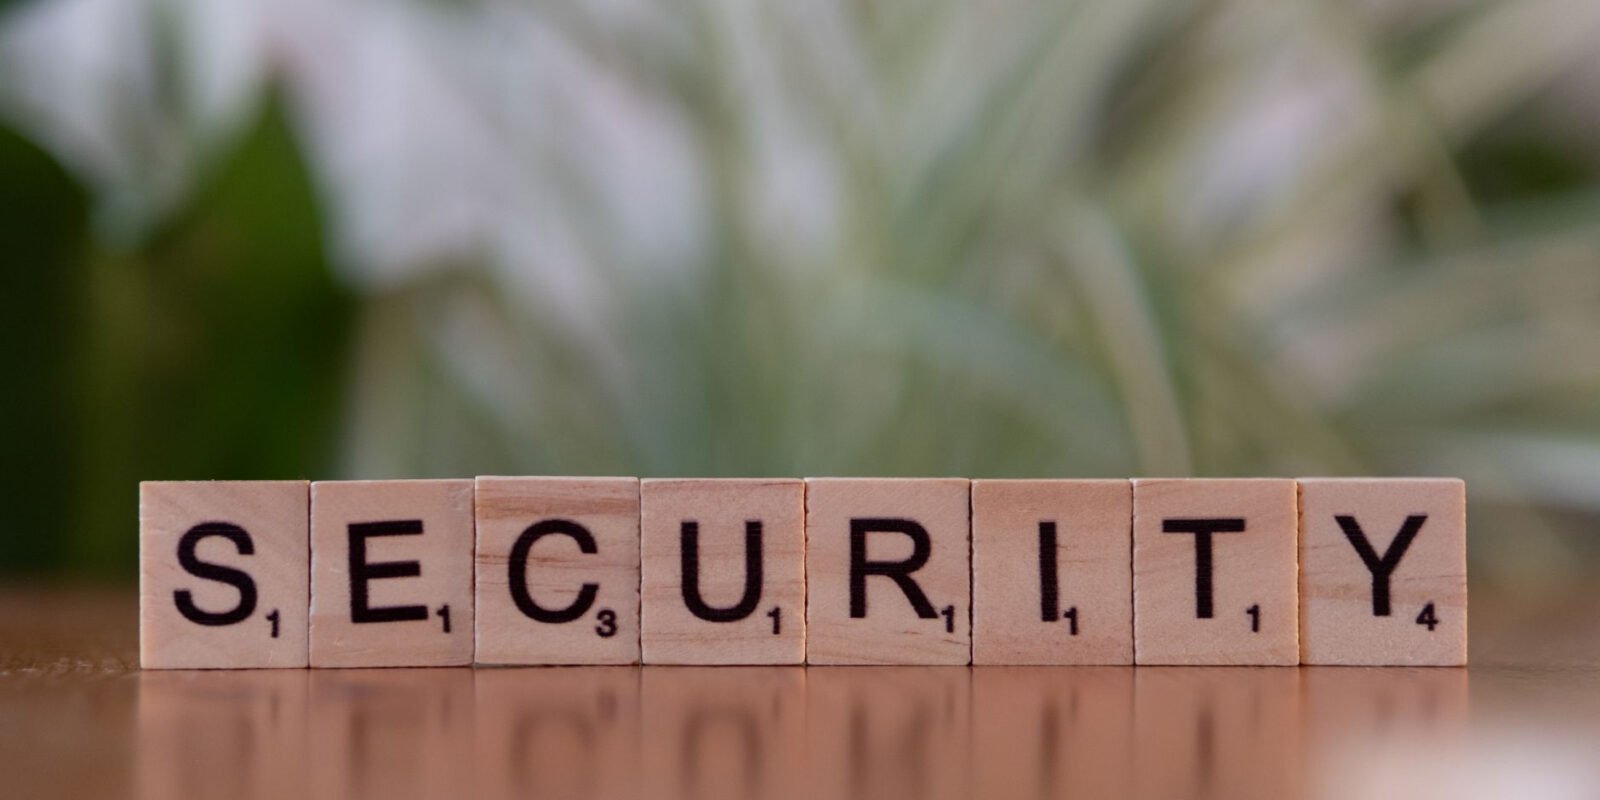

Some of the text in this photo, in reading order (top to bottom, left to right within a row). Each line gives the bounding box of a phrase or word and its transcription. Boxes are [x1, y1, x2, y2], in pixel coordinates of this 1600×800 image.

[173, 515, 1429, 627] SECURITY
[265, 609, 280, 639] 1
[435, 604, 452, 634] 1
[594, 608, 619, 639] 3
[766, 606, 781, 636] 1
[940, 604, 955, 634] 1
[1062, 606, 1079, 636] 1
[1245, 604, 1261, 633] 1
[1415, 602, 1440, 632] 4
